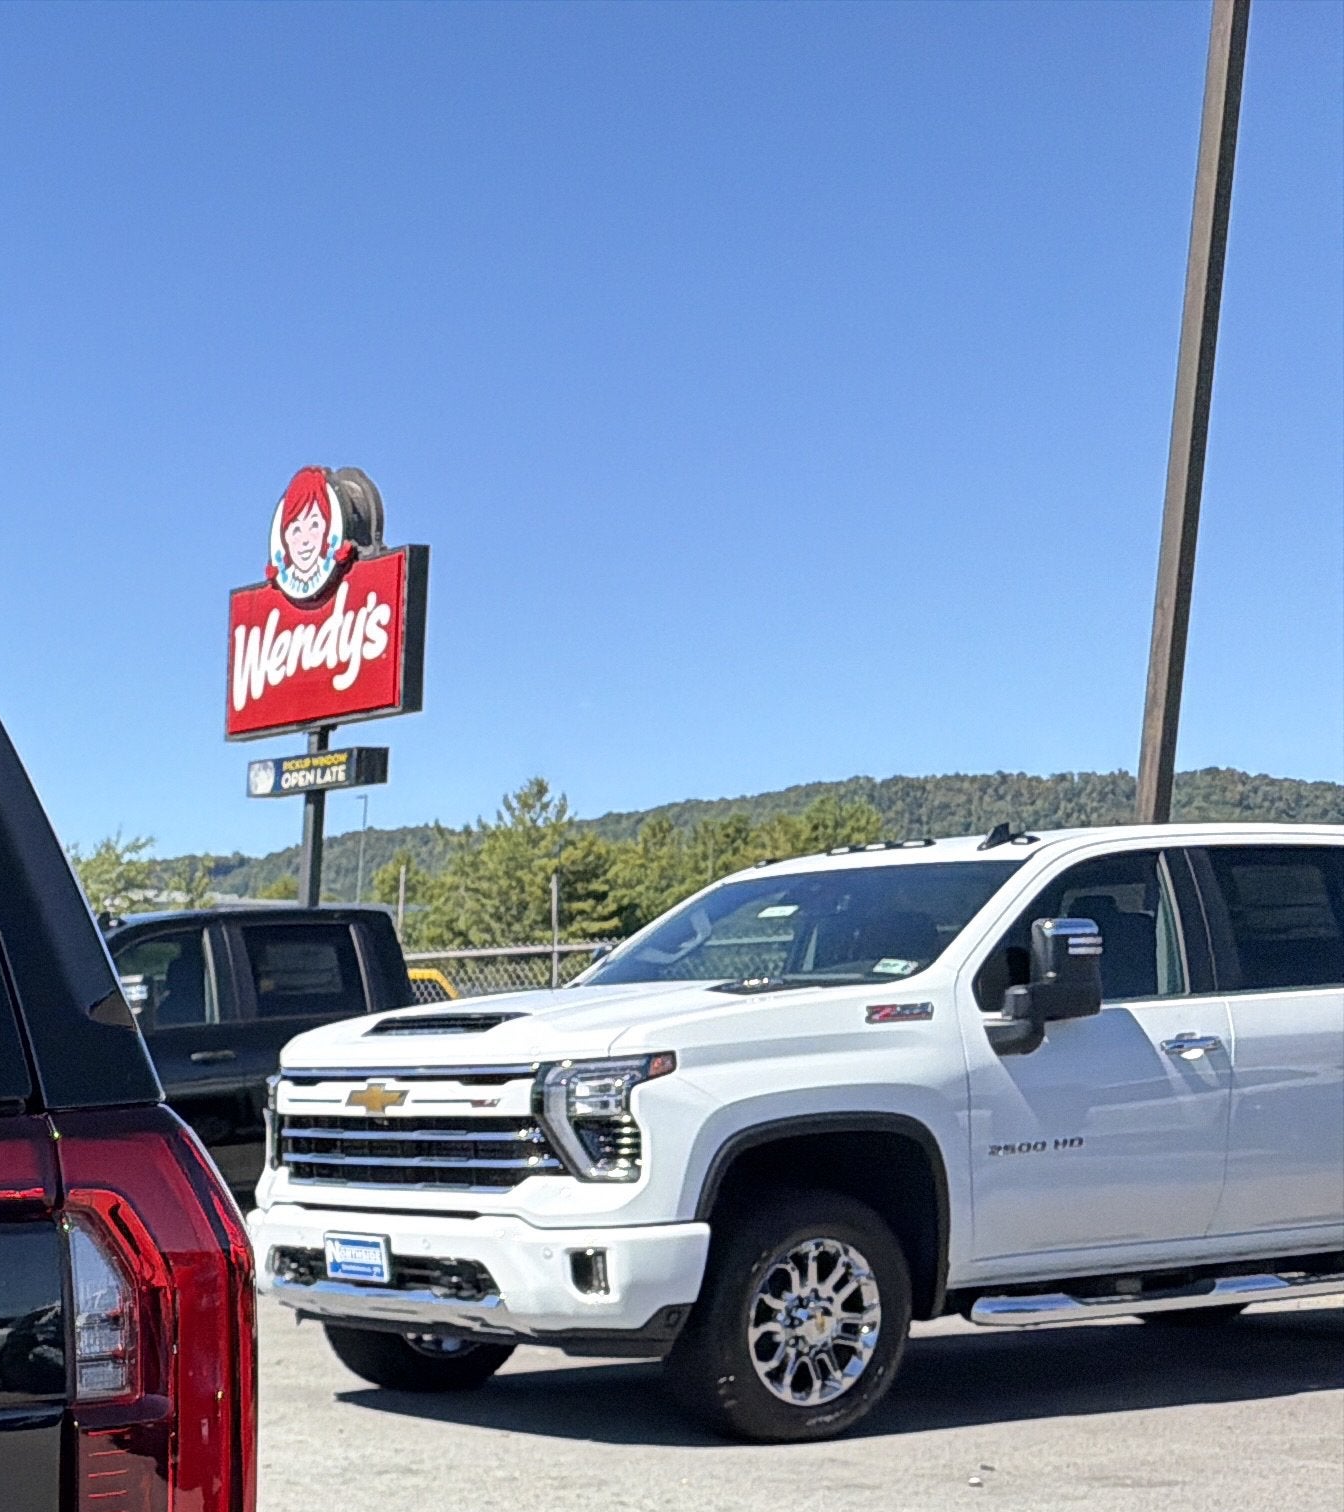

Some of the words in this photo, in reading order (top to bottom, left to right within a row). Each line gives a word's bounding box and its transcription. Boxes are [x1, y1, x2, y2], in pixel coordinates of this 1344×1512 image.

[233, 581, 391, 711] Wendy's
[280, 769, 315, 789] OPEN
[316, 764, 347, 785] LATE
[988, 1141, 1047, 1156] 2500
[1053, 1136, 1084, 1151] HD
